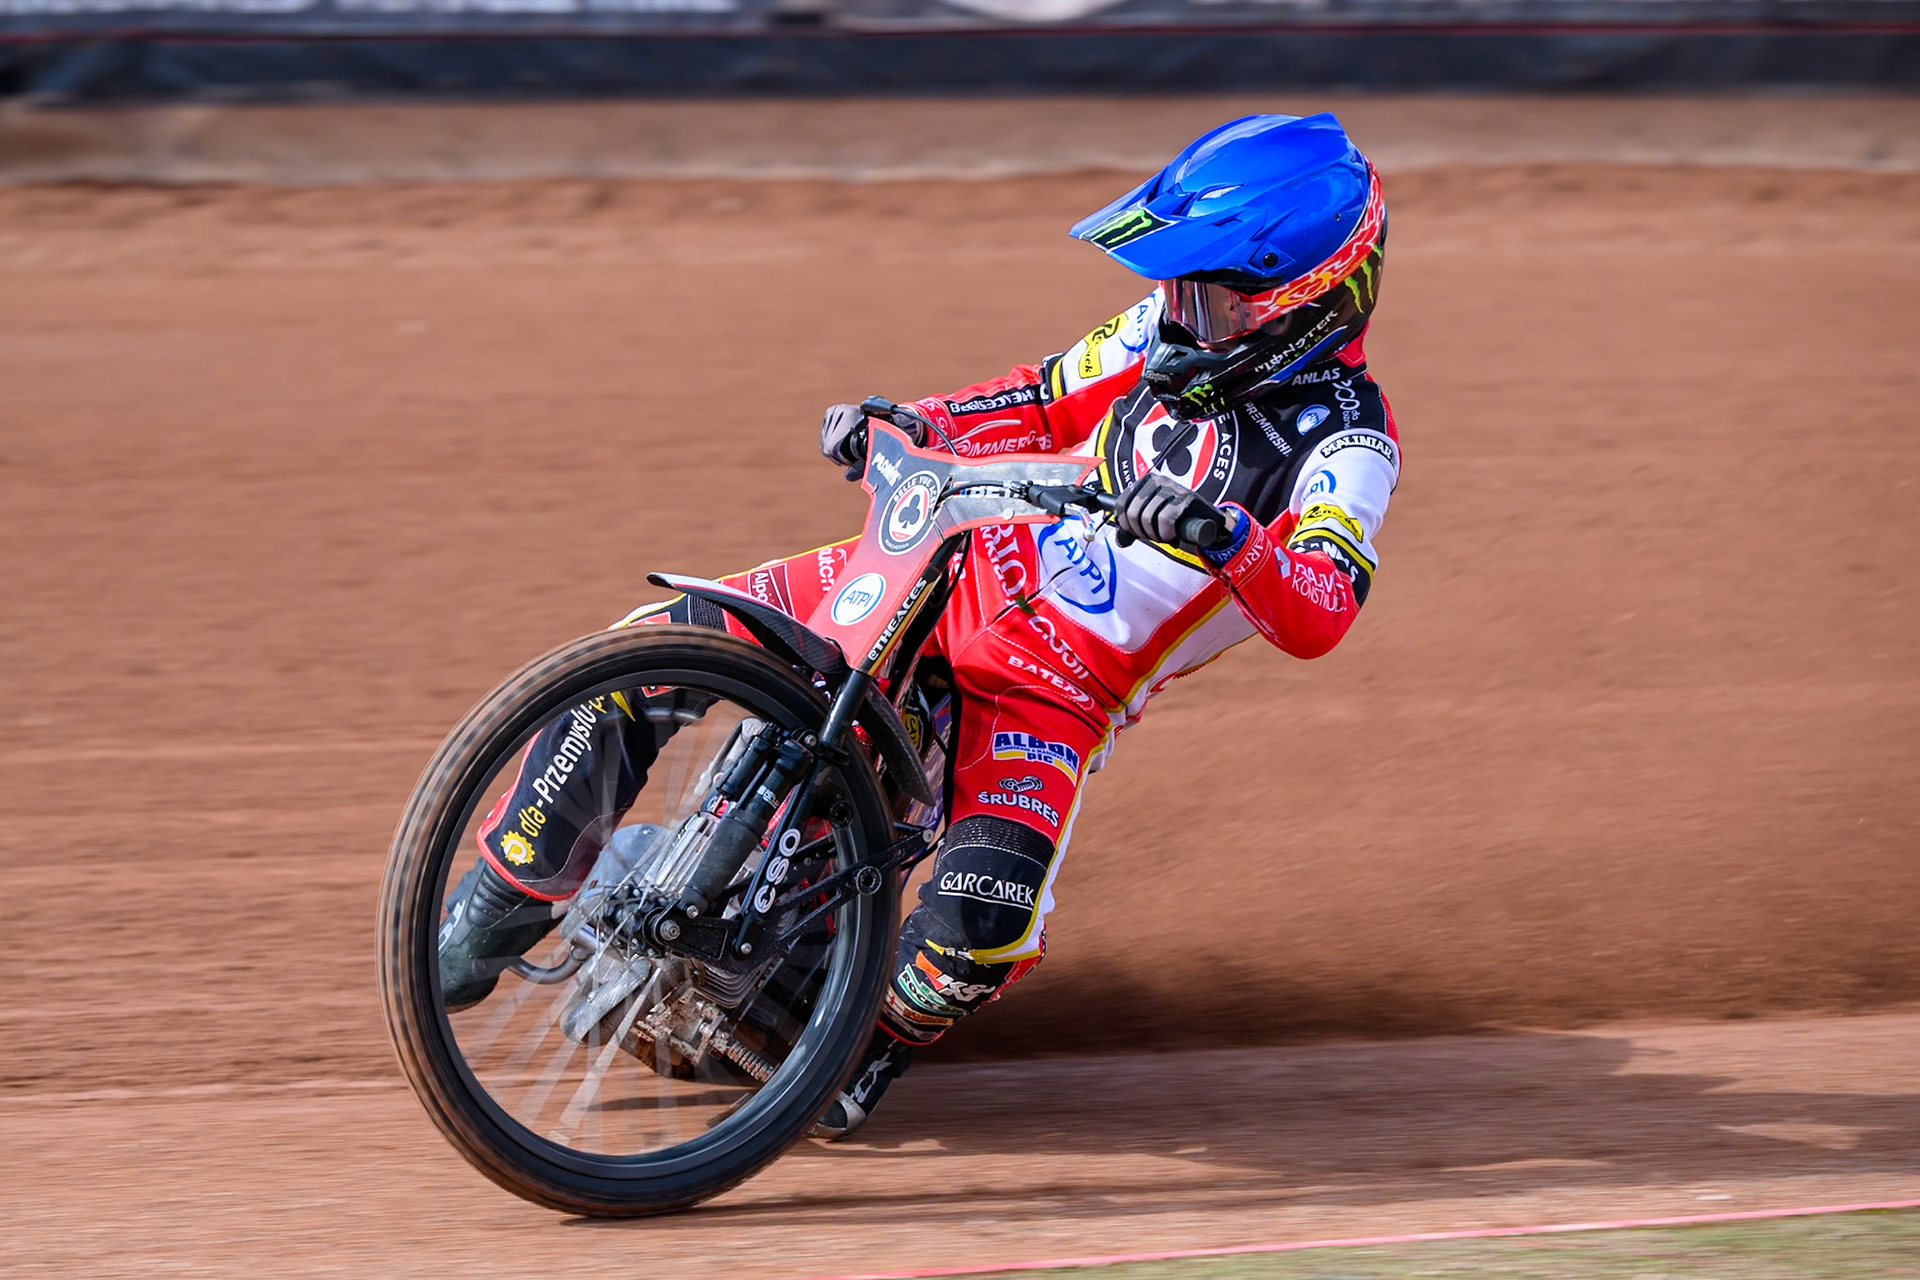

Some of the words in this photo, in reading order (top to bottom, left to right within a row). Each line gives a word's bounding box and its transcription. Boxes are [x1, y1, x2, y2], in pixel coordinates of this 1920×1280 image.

[1292, 368, 1340, 386] ANLAS
[1213, 432, 1232, 481] ACES
[842, 589, 872, 608] ATPI
[994, 733, 1078, 768] ALBON
[978, 791, 1059, 828] ŚRUBRES
[941, 871, 1034, 906] GARCAREK
